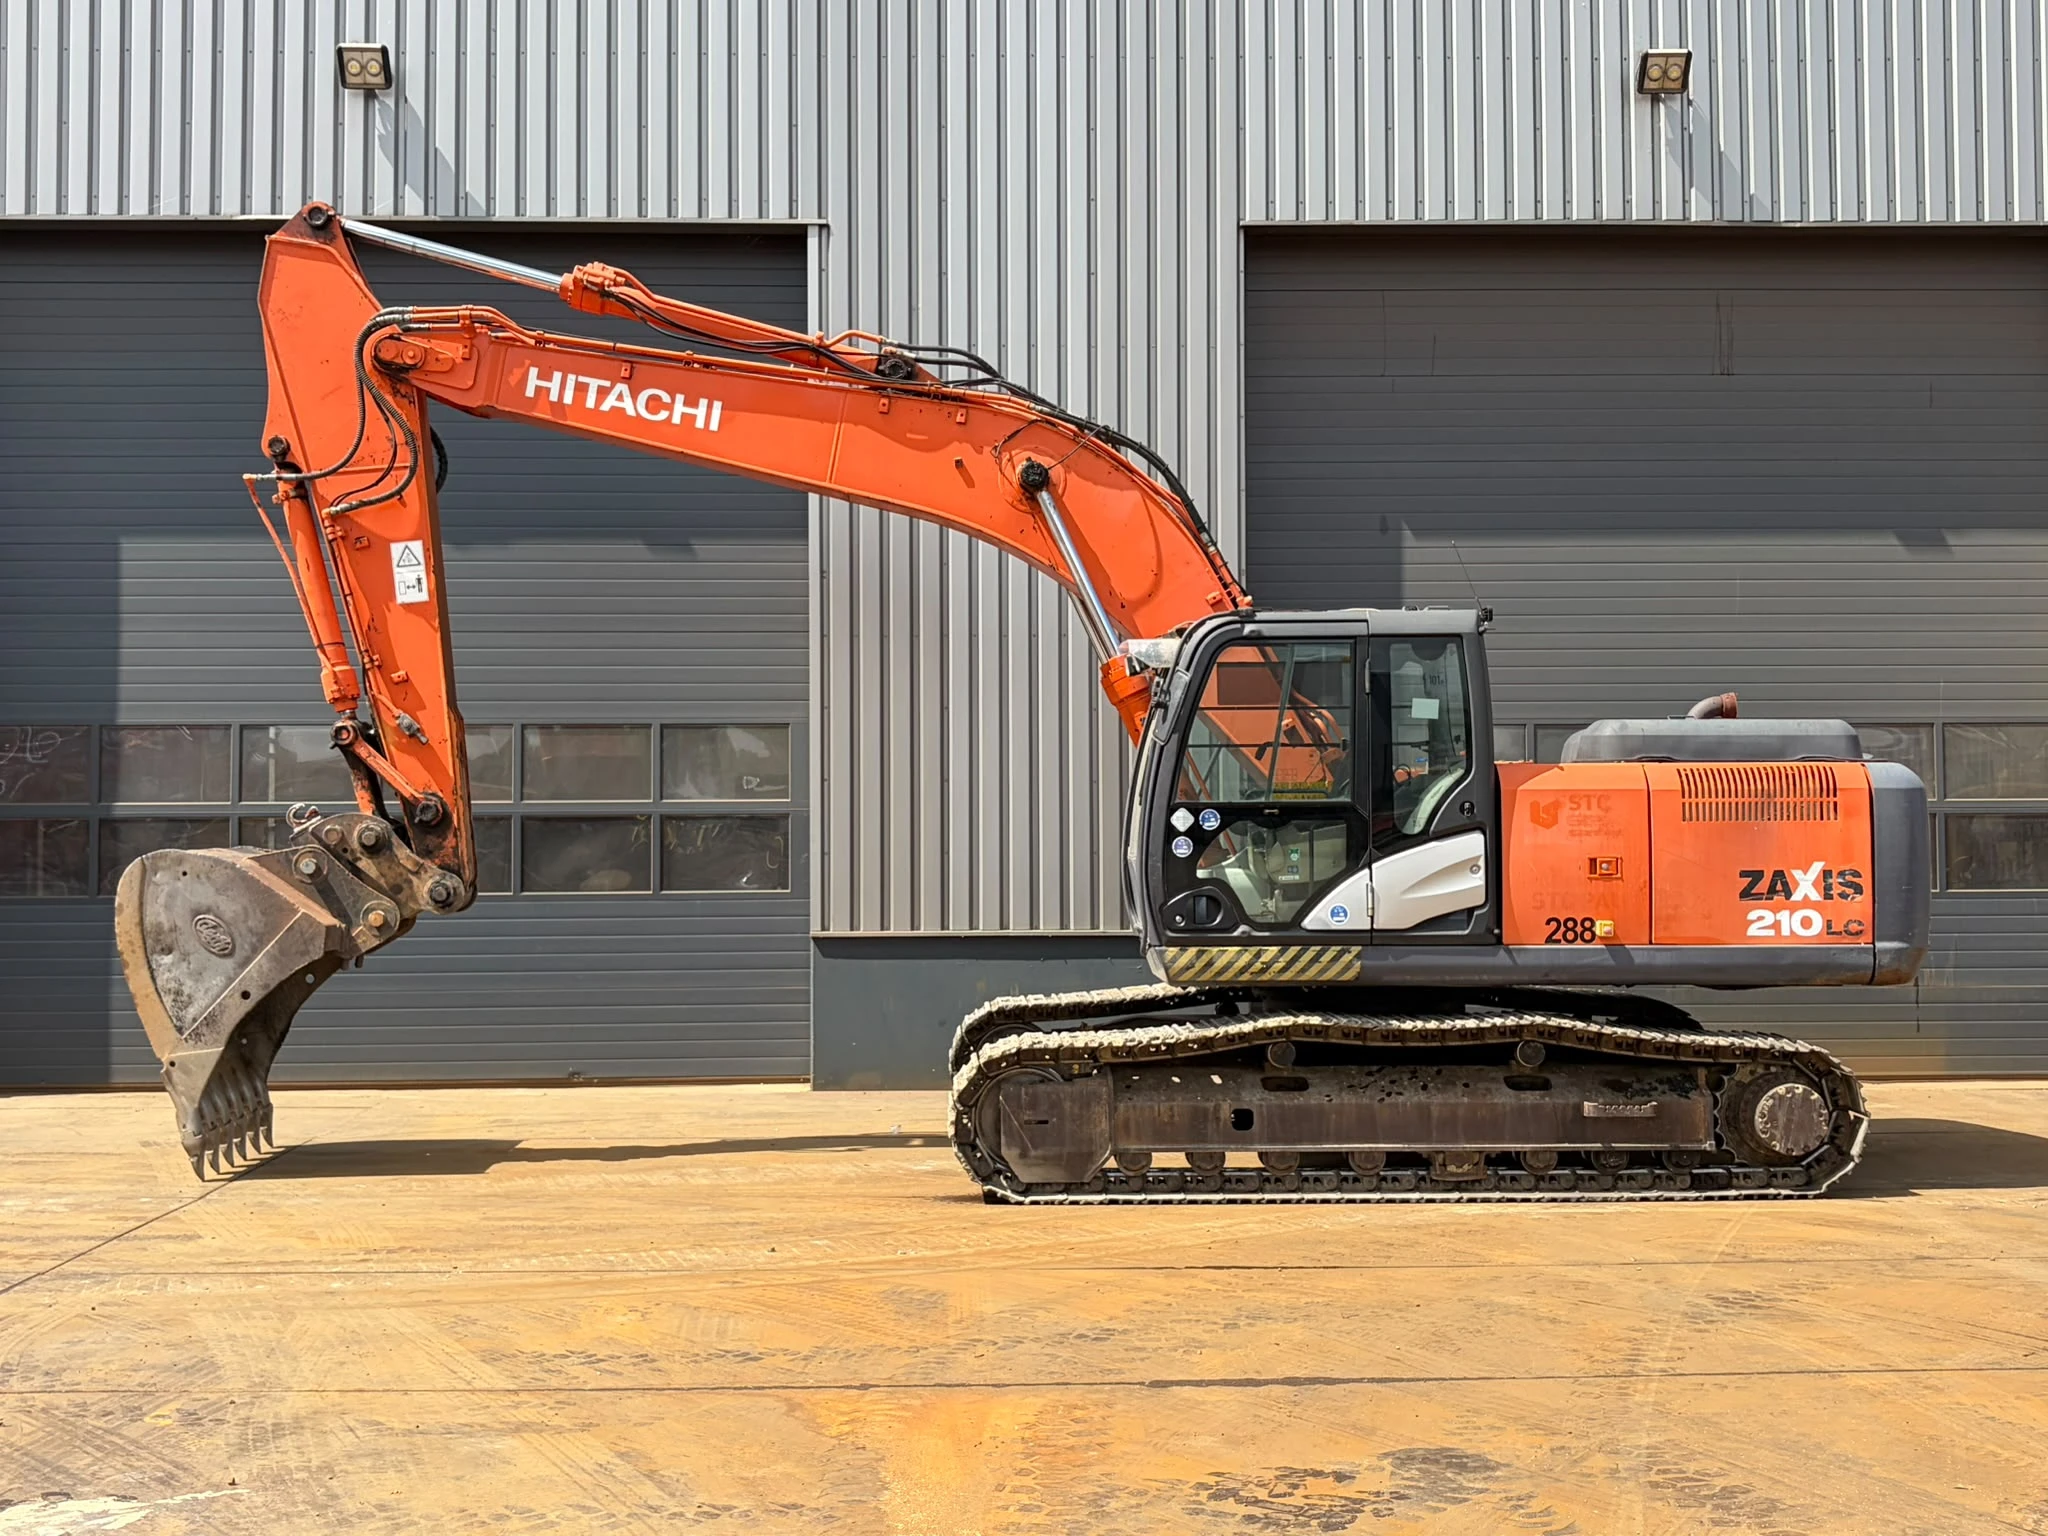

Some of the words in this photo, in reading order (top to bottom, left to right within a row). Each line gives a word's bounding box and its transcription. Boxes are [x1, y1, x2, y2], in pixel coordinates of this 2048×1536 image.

[524, 366, 723, 431] HITACHI
[1739, 861, 1864, 902] ZAXIS
[1545, 917, 1597, 944] 288
[1746, 908, 1823, 937] 210
[1826, 919, 1865, 937] LC
